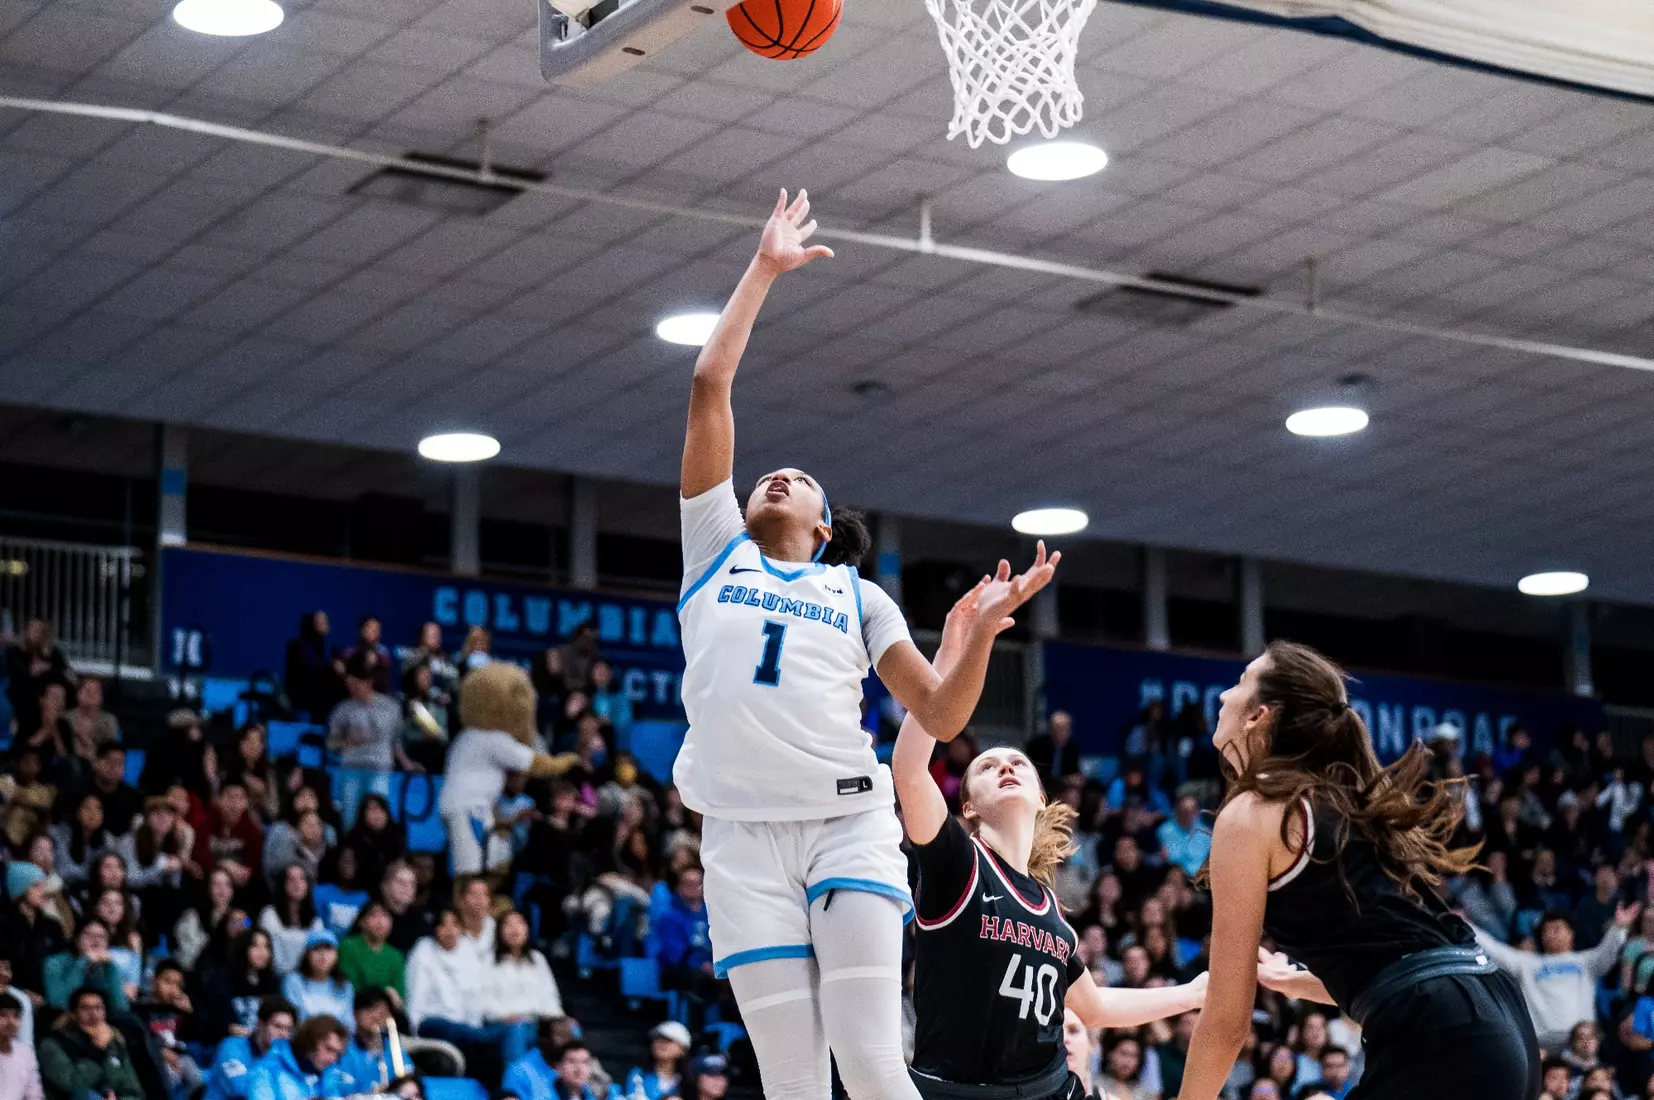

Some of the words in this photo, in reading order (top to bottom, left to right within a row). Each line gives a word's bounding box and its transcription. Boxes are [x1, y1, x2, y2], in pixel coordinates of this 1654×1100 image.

[433, 585, 680, 646] COLUMBIA
[717, 585, 849, 635] COLUMBIA
[752, 619, 788, 687] 1
[998, 953, 1059, 1027] 40
